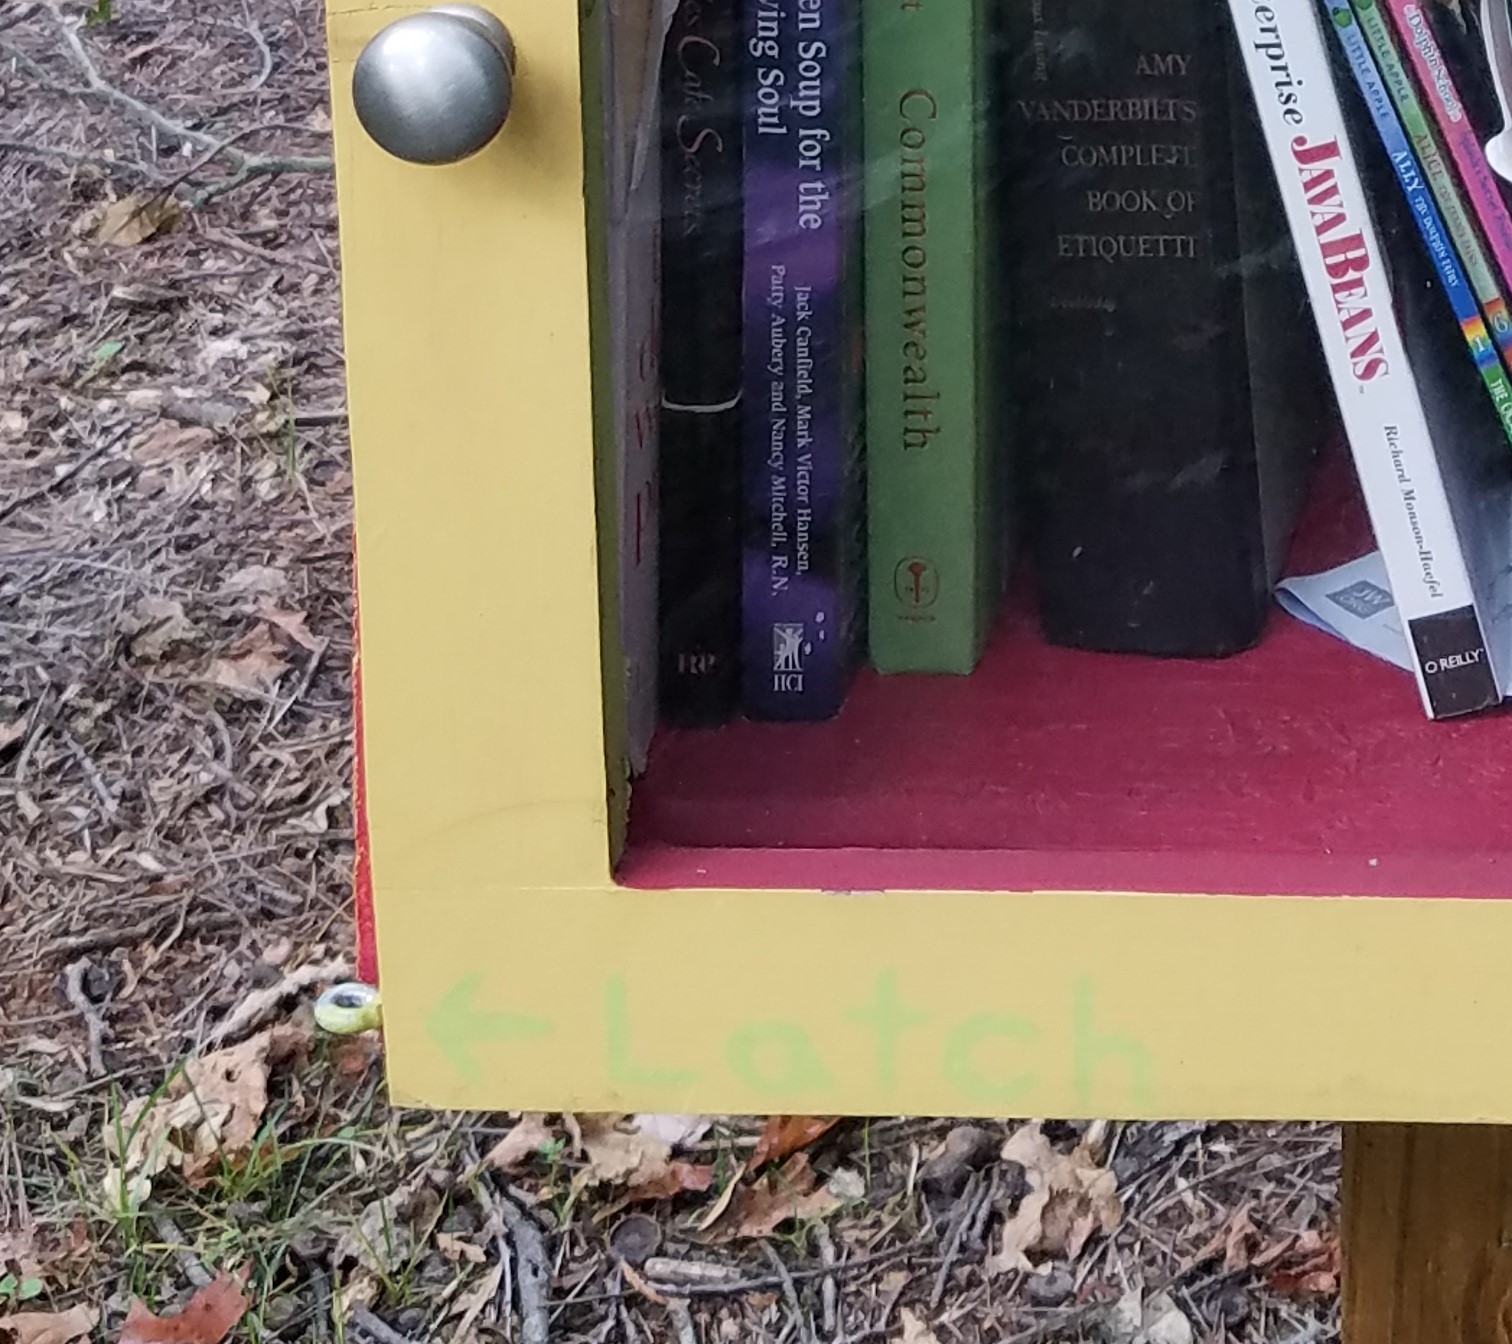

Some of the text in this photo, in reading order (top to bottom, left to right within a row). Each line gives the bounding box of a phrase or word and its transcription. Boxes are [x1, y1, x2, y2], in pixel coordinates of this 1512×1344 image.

[789, 42, 829, 114] Soup
[1135, 53, 1193, 77] AMY
[1366, 15, 1409, 104] LITTLE APPLE
[1406, 11, 1460, 115] Dolphin School
[756, 67, 787, 136] Soul
[1365, 80, 1390, 119] APPLE
[797, 126, 832, 171] for
[1392, 150, 1424, 193] ALLY
[798, 178, 831, 230] the
[1085, 189, 1159, 213] BOOK
[769, 264, 788, 305] Patty
[898, 88, 941, 451] Commonwealth
[768, 311, 788, 376] Aubery
[1475, 335, 1485, 352] 1
[1494, 313, 1509, 332] 6
[769, 379, 787, 413] and
[1490, 378, 1507, 403] THE
[768, 418, 788, 473] Nancy
[794, 285, 814, 576] Jack Canfield, Mark Victor Hansen,
[1383, 423, 1444, 599] Richard Monson-Haefel
[770, 556, 790, 597] R.N.
[604, 966, 1156, 1102] Latch
